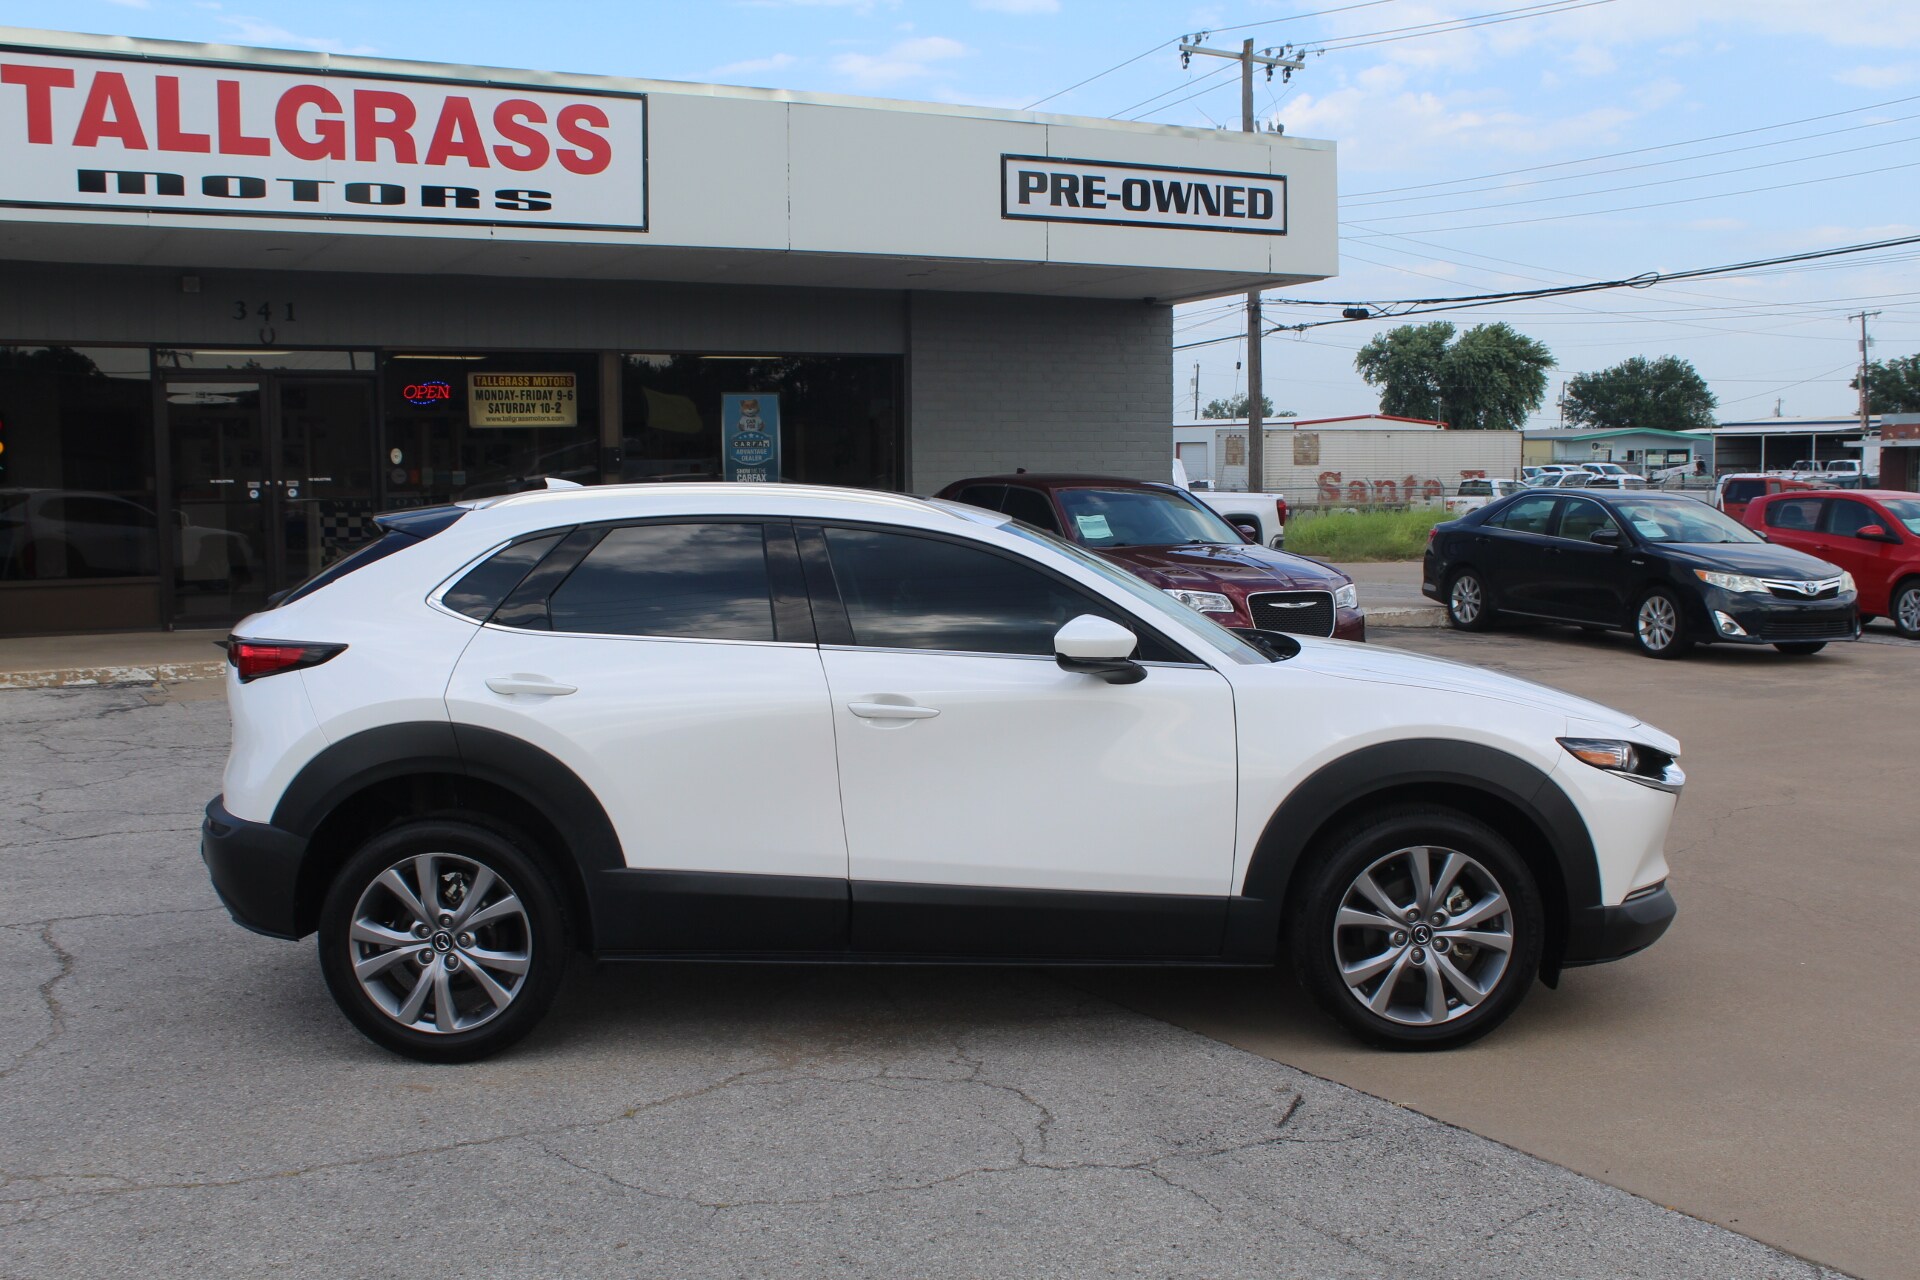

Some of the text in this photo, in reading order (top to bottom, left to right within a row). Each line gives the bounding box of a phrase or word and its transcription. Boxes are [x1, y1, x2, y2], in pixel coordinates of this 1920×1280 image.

[1, 63, 613, 176] TALLGRASS
[1017, 170, 1274, 220] PRE-OWNED
[475, 376, 573, 386] TALLGRASS MOTORS
[403, 384, 451, 399] OPEN
[475, 389, 574, 401] MONDAY-FRIDAY 9-6
[488, 402, 562, 414] SATURDAY 10-2
[734, 440, 770, 448] CARFAX
[736, 474, 767, 482] CARFAX
[1318, 471, 1441, 502] Santa
